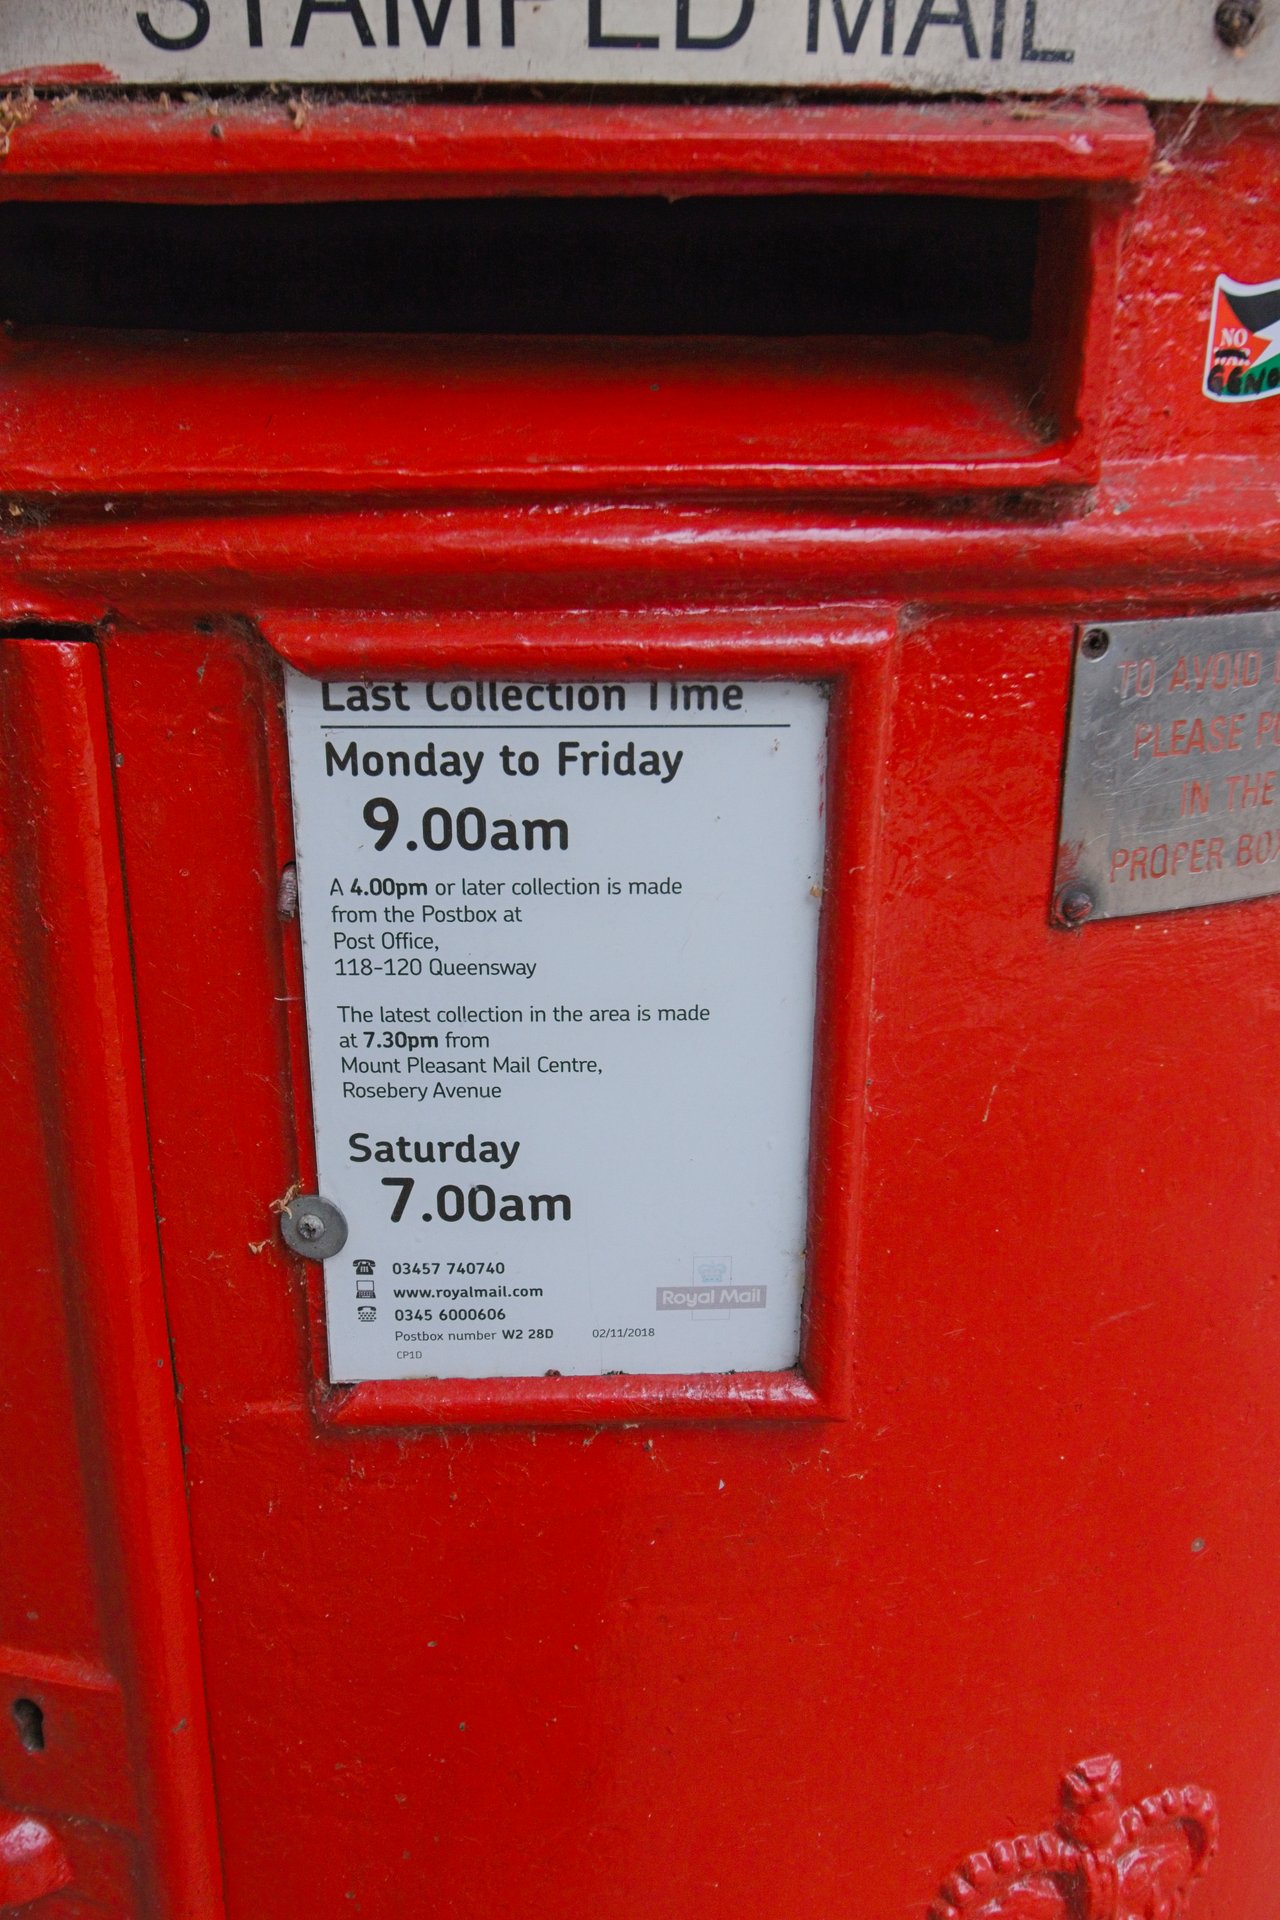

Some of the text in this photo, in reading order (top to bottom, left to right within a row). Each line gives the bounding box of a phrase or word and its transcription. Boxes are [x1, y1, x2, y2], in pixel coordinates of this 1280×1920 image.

[1219, 327, 1249, 348] NO
[1117, 657, 1157, 699] TO
[1168, 649, 1262, 693] AVOID
[321, 682, 411, 712] Last
[425, 682, 626, 712] Collection
[1132, 713, 1246, 760] PLEASE
[324, 740, 684, 786] Monday to Friday
[1180, 770, 1278, 816] IN THE
[362, 796, 569, 852] 9.00am
[1110, 837, 1225, 883] PROPER
[329, 876, 683, 901] A 4.00pm or later collection is made
[330, 904, 523, 924] from the Postbox at
[333, 931, 440, 952] Post Office,
[334, 957, 537, 980] 118-120 Queensway
[336, 1003, 711, 1024] The latest collection in the area is made
[338, 1030, 490, 1053] at 7.30pm from
[340, 1055, 603, 1076] Mount Pleasant Mail Centre,
[342, 1081, 502, 1103] Rosebery Avenue
[348, 1132, 521, 1170] Saturday
[380, 1176, 572, 1224] 7.00am
[391, 1261, 506, 1276] 03457 740740
[392, 1284, 544, 1301] www.royalmail.com
[662, 1287, 761, 1307] Royal Mail
[394, 1307, 507, 1322] 0345 6000606
[394, 1328, 554, 1342] Postbox number W2 28D
[592, 1327, 656, 1339] 02/11/2018
[396, 1350, 423, 1360] CP1D
